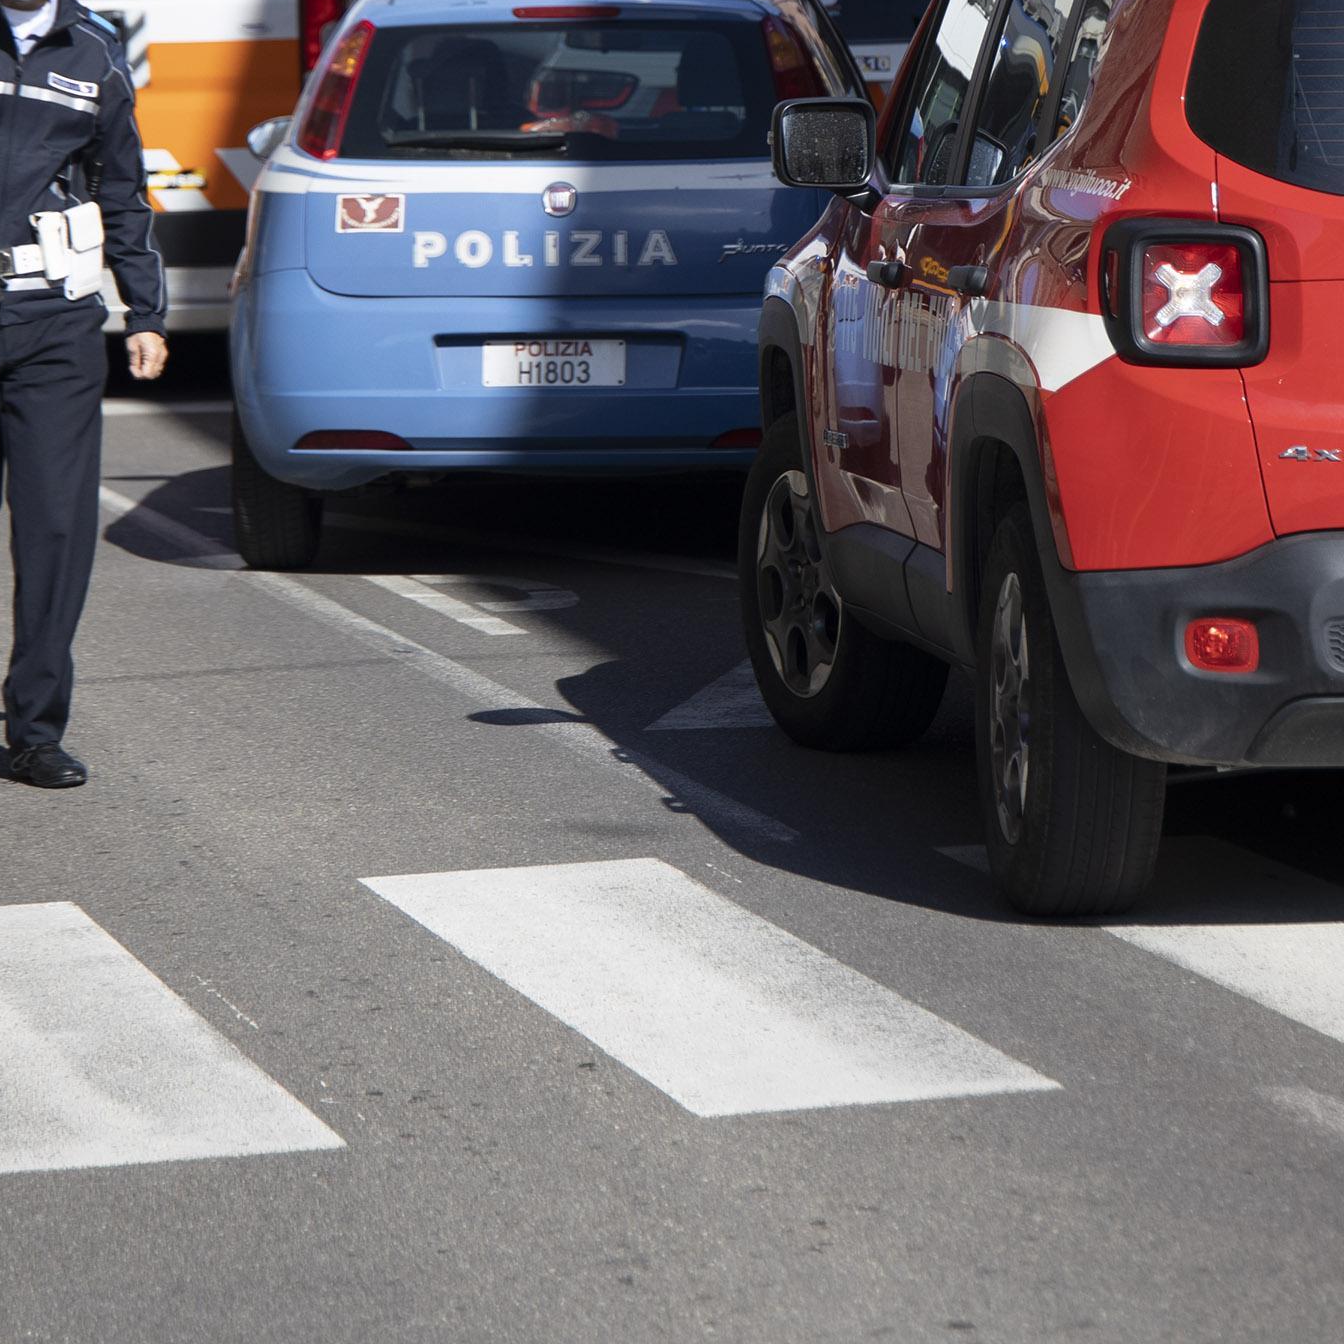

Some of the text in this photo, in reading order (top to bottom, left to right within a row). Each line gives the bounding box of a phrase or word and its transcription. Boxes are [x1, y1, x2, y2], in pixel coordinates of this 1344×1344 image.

[413, 229, 679, 268] POLIZIA
[514, 340, 593, 357] POLIZIA
[518, 361, 591, 384] H1803
